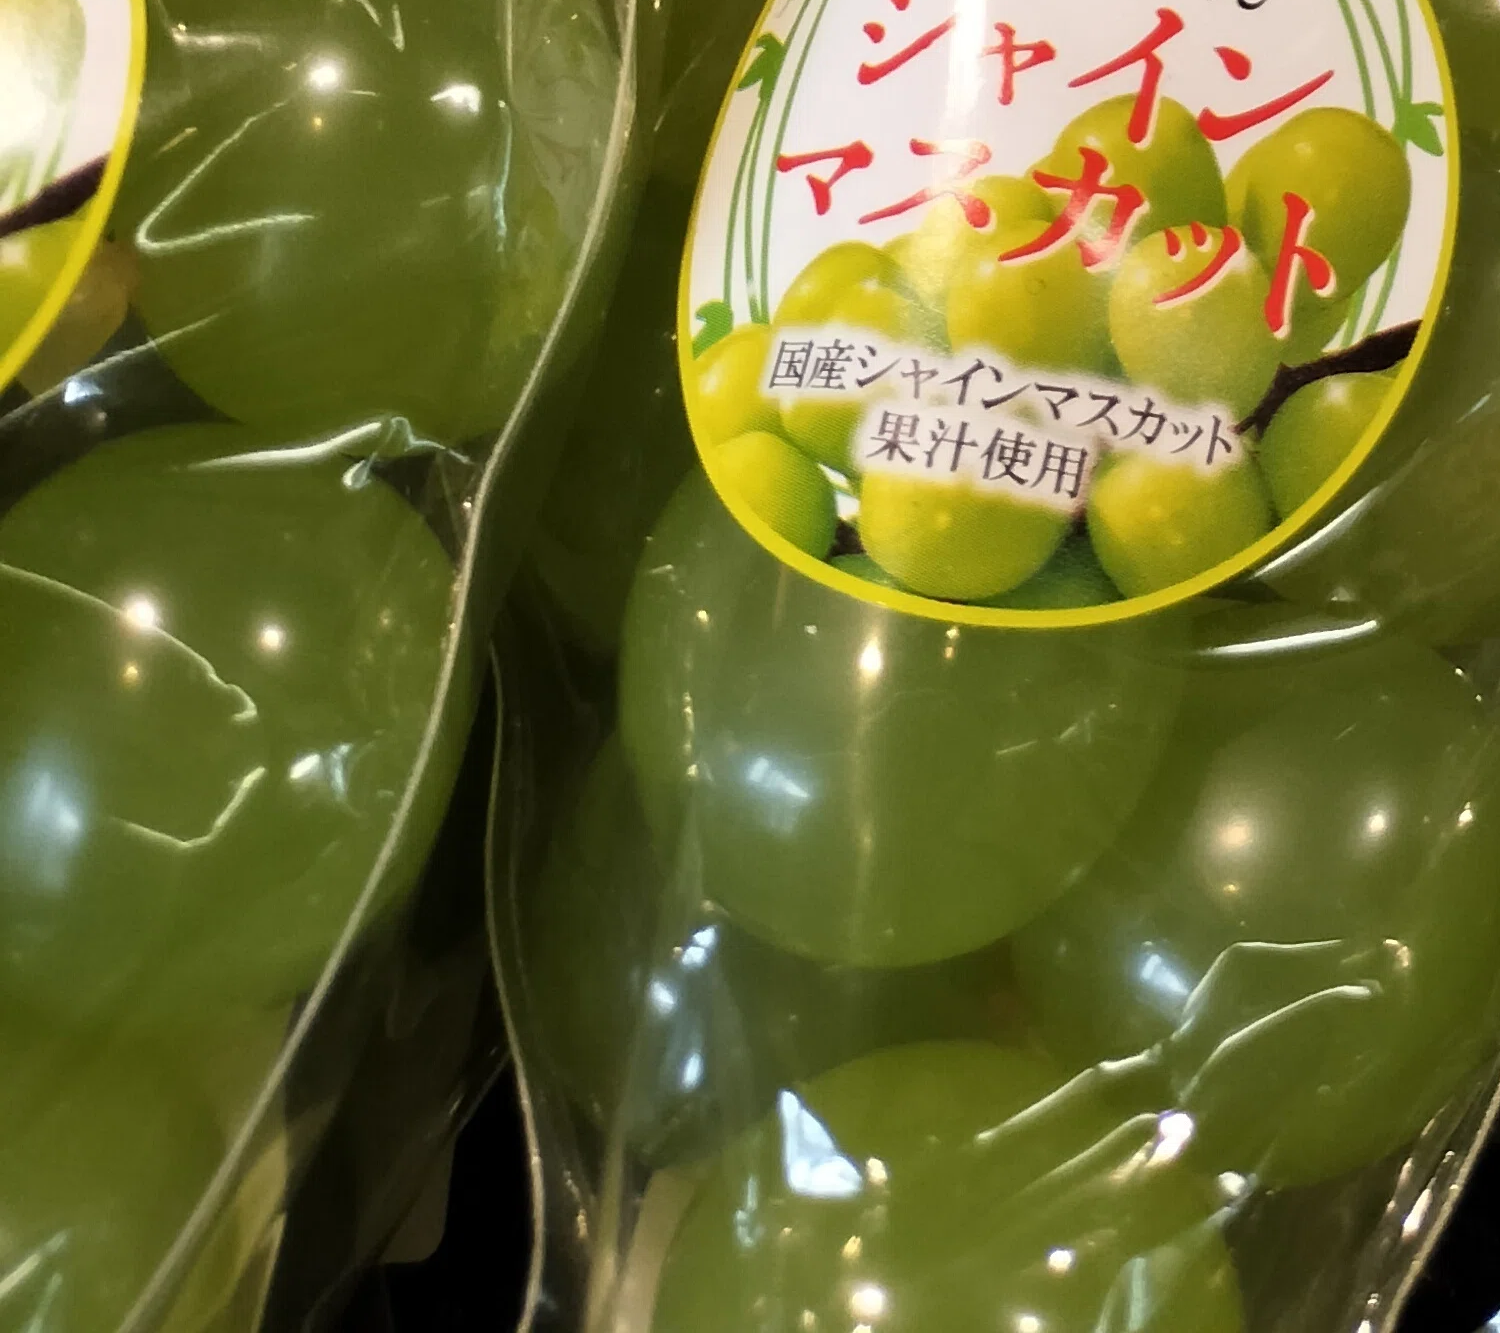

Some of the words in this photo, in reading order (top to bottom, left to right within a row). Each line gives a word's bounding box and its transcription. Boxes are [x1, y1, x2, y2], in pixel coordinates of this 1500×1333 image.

[775, 137, 1338, 335] マスカット
[768, 338, 1234, 466] 国産シャインマスカット
[866, 410, 1090, 499] 果汁使用
